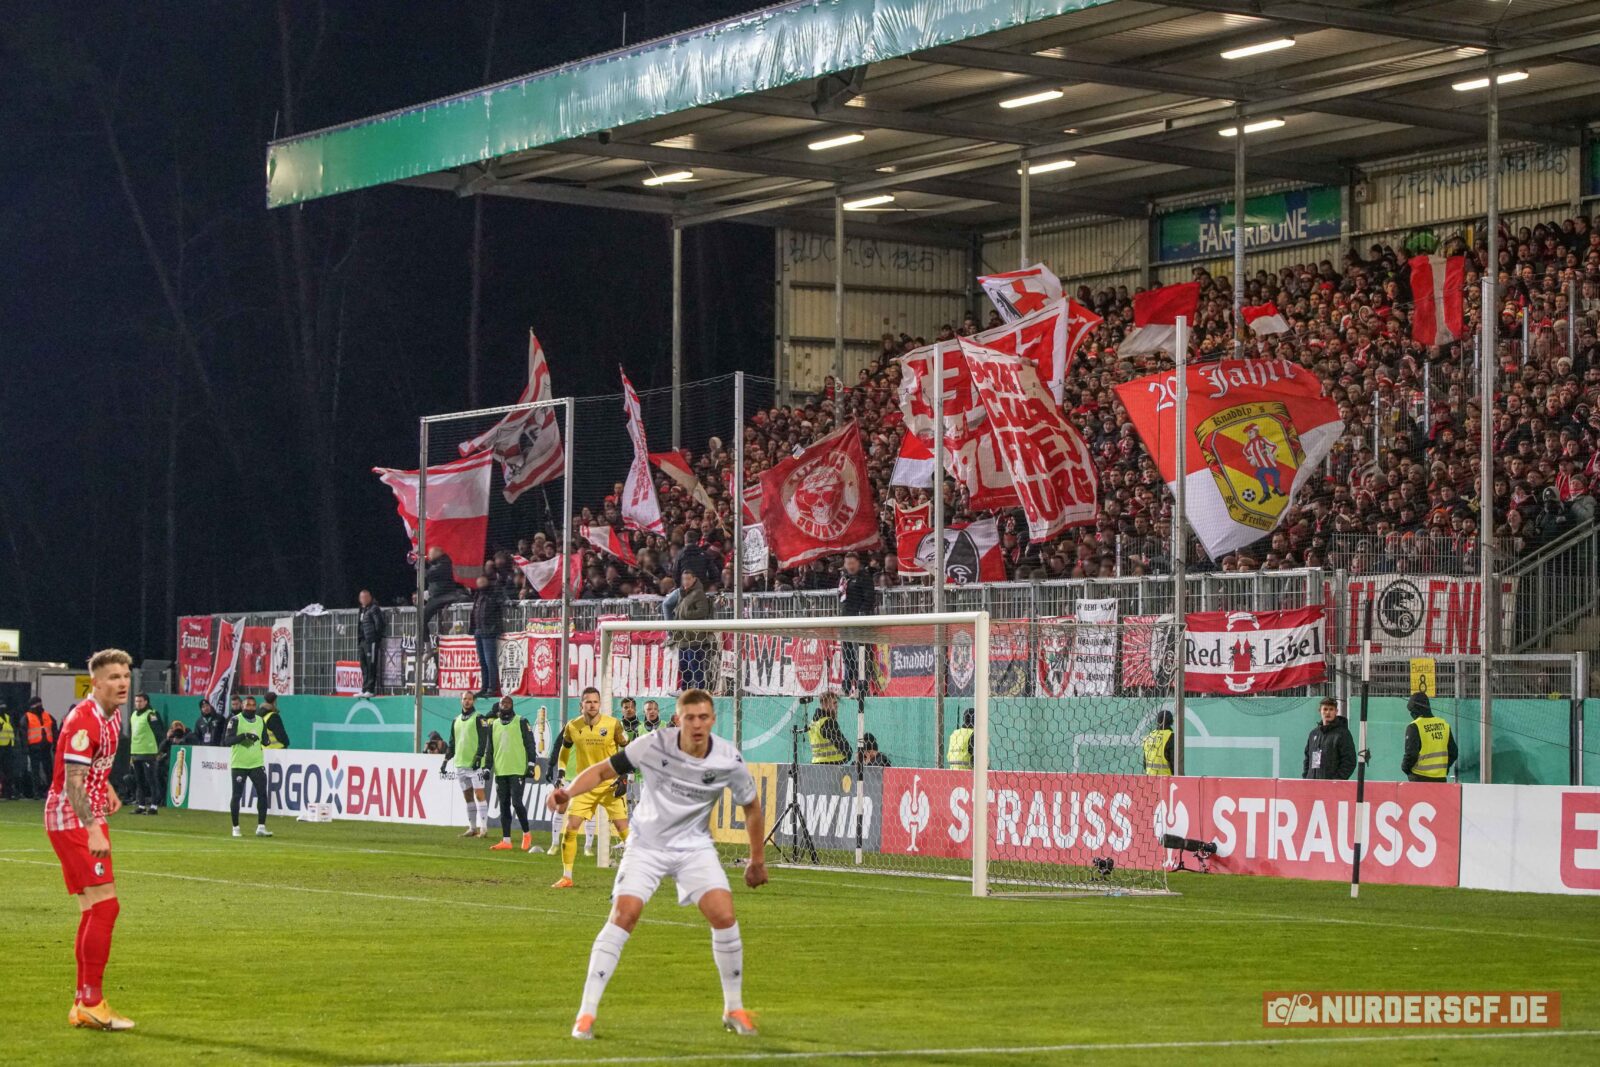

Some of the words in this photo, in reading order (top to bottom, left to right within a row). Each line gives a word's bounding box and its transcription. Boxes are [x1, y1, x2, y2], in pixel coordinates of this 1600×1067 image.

[1200, 207, 1307, 253] FAN-RIBUNE
[1148, 376, 1188, 412] 20
[1199, 359, 1298, 399] Jahre
[440, 649, 480, 667] SYNTHES
[893, 650, 935, 672] Knaddly
[1185, 638, 1222, 667] Red
[1264, 626, 1324, 666] Label
[441, 671, 471, 689] ULTRAS
[1418, 673, 1428, 693] 8
[1423, 722, 1446, 733] SECURITY
[241, 763, 322, 812] ARGO
[346, 765, 429, 820] BANK
[948, 787, 1133, 853] SRAUSS
[1210, 795, 1438, 867] STRAUSS
